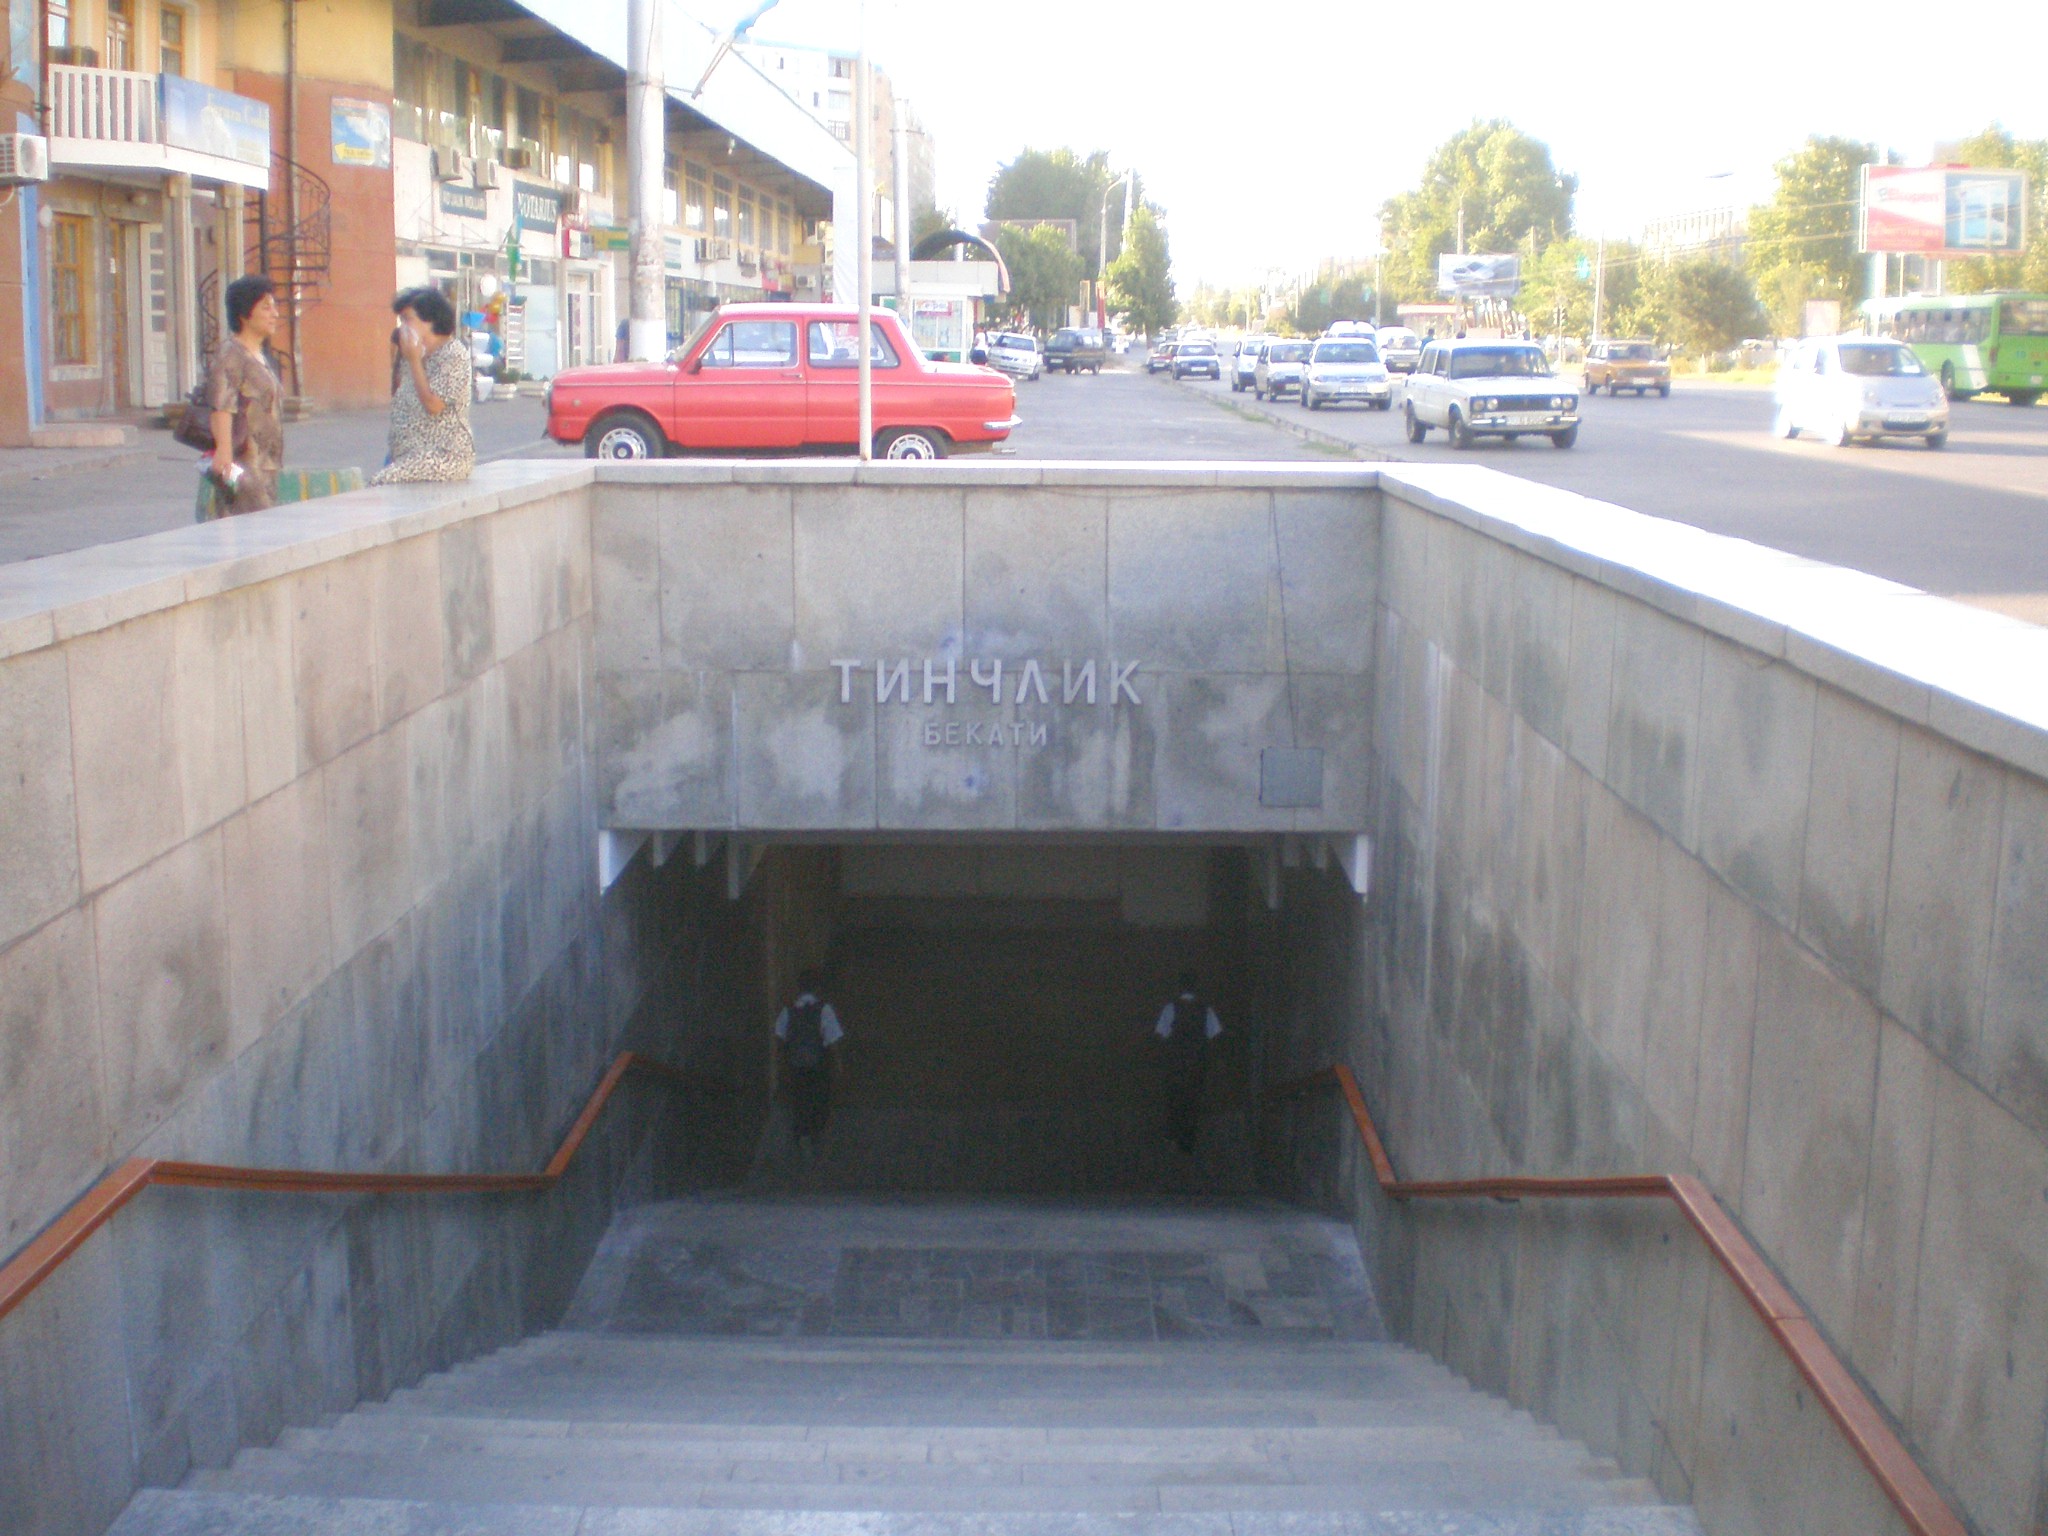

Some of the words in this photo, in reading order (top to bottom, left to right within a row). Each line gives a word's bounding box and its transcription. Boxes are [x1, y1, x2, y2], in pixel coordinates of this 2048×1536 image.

[518, 192, 557, 222] NOTARIUS
[830, 659, 1142, 705] ТИНЧЛИК
[924, 722, 1048, 746] БЕКАТИ
